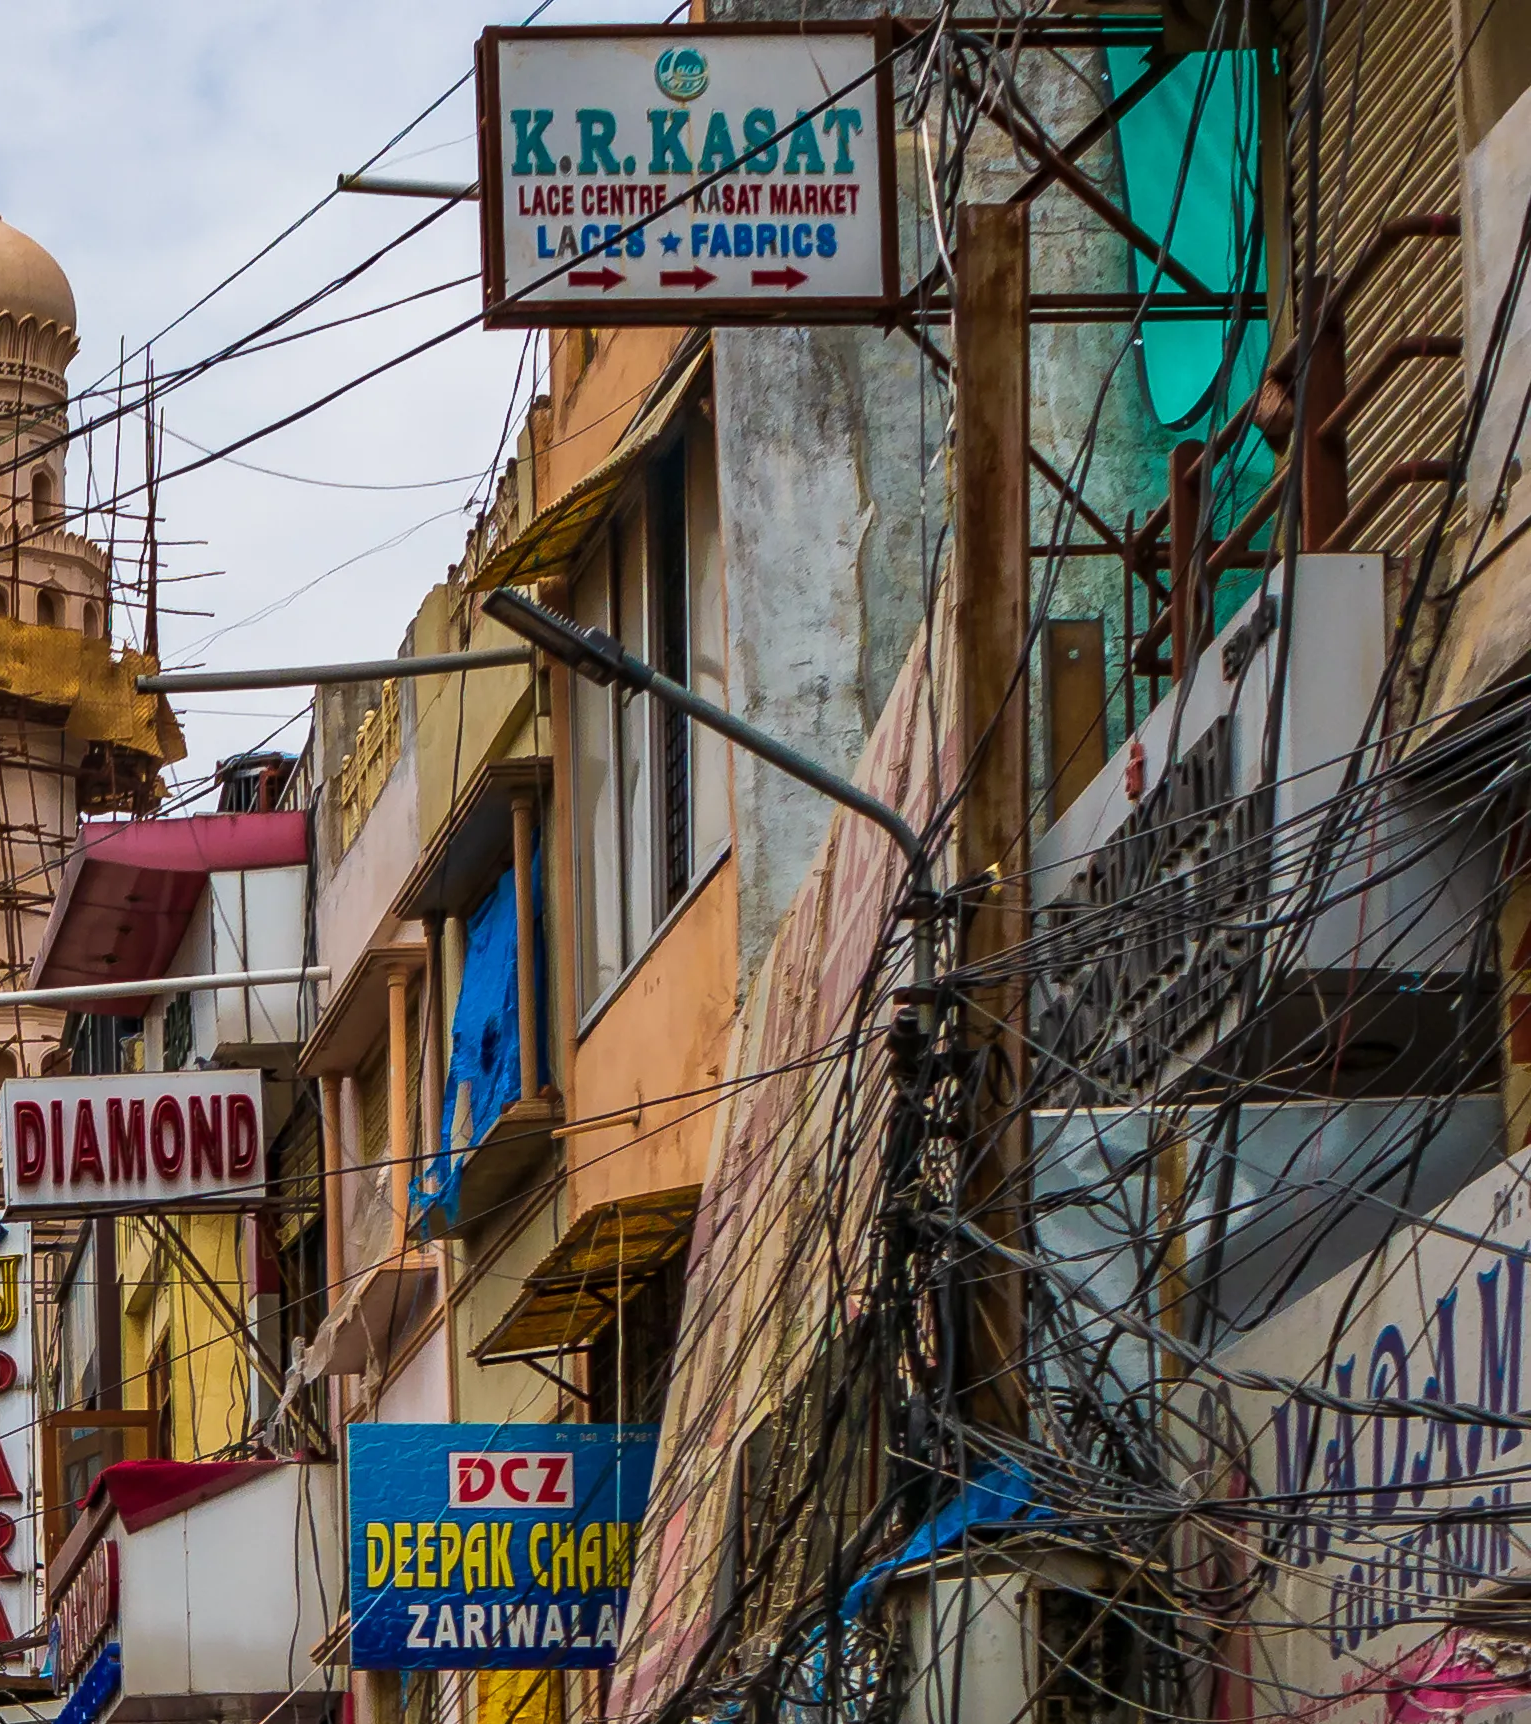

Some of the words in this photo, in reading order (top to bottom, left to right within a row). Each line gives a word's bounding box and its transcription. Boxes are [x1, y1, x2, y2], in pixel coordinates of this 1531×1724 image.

[518, 185, 575, 216] LACE
[581, 184, 666, 216] CENTRE
[693, 184, 762, 215] KASAT
[770, 184, 860, 216] MARKET
[536, 224, 646, 259] LACES
[691, 223, 838, 259] FABRICS
[13, 1093, 258, 1187] DIAMOND
[457, 1457, 568, 1503] DCZ
[366, 1522, 515, 1596] DEEPAK
[406, 1604, 619, 1649] ZARIWALA
